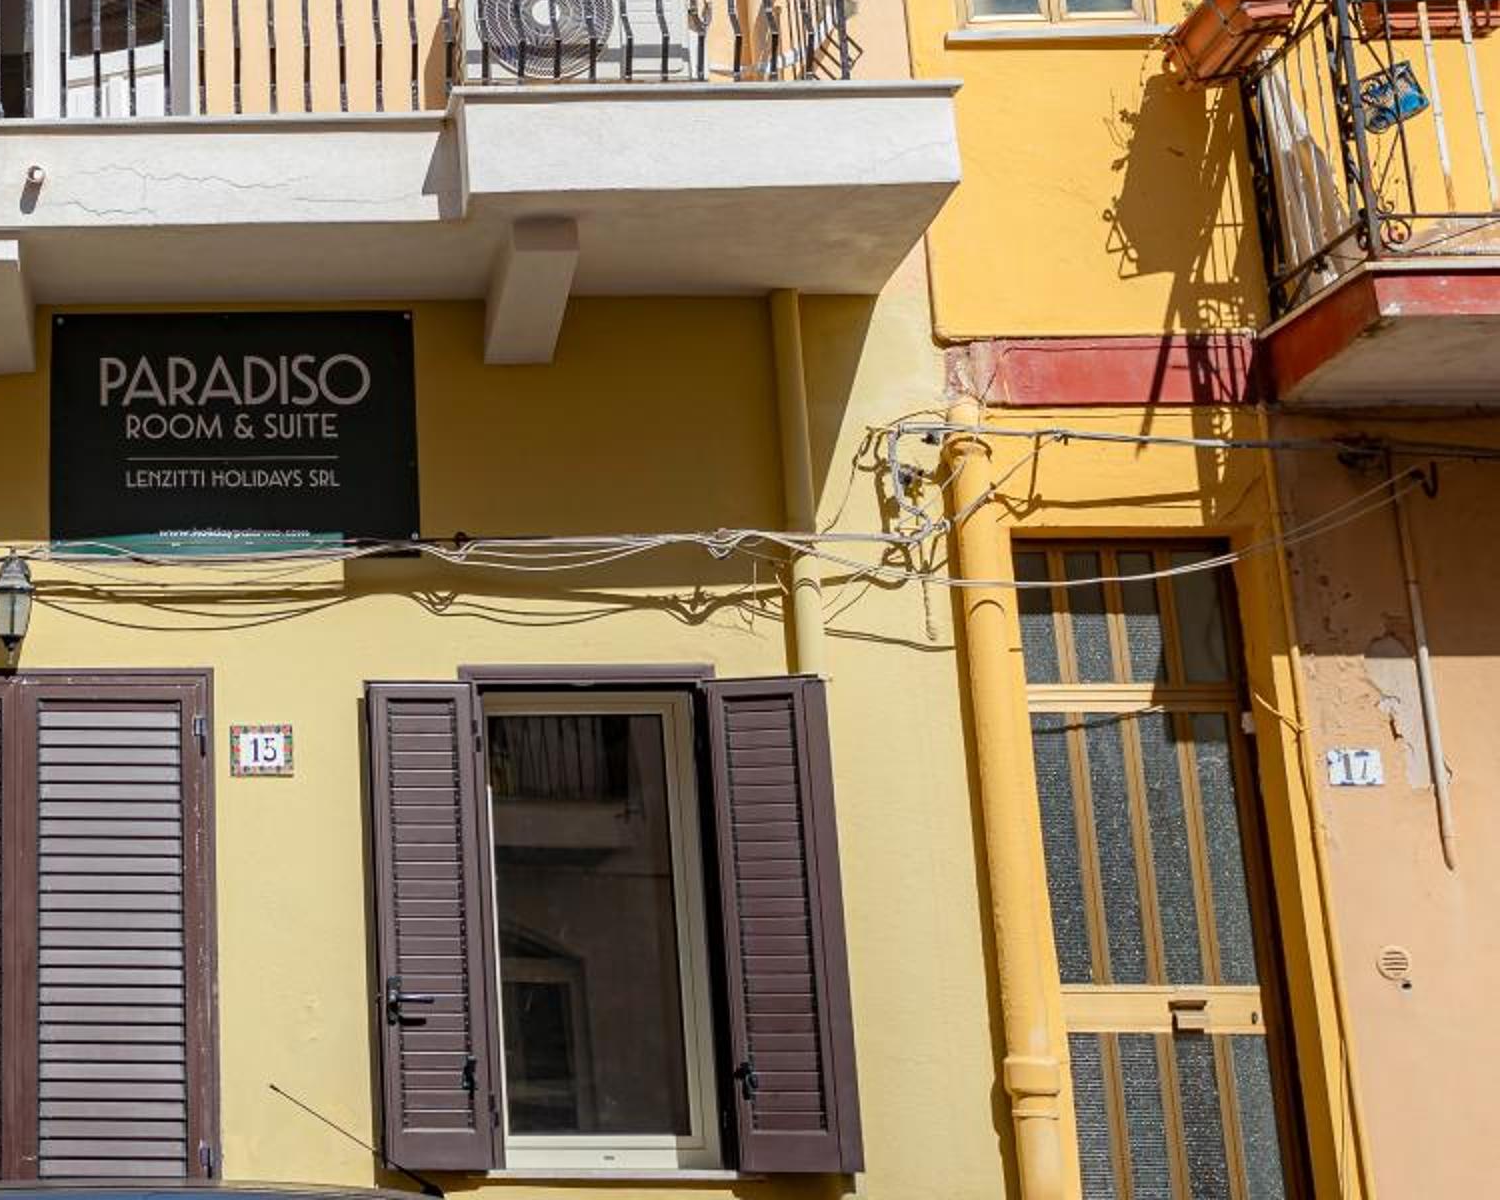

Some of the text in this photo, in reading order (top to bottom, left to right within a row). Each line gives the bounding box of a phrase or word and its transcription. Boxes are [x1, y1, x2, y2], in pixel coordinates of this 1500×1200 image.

[100, 354, 371, 406] PARADISO
[126, 413, 339, 439] ROOM & SUITE
[126, 469, 340, 488] LENZITTI HOLIDAYS SRL
[250, 737, 277, 762] 15
[1340, 751, 1370, 780] 17
